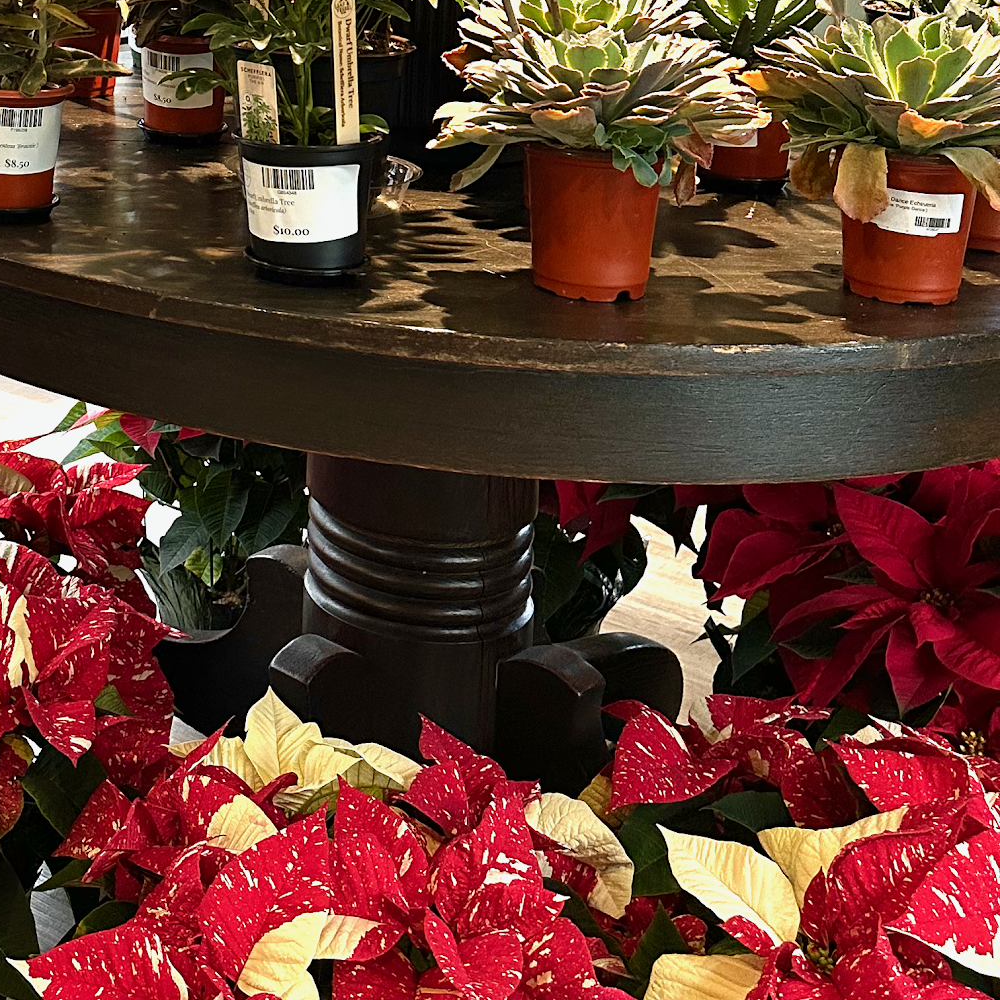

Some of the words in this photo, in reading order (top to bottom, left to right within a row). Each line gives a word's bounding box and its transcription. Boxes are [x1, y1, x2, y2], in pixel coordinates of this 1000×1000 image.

[345, 18, 353, 46] Dwarf
[240, 66, 272, 77] SCHEFFLERA
[4, 158, 30, 169] $8.50
[279, 198, 295, 206] Tree
[890, 196, 909, 205] Dance
[273, 225, 310, 236] $10.00
